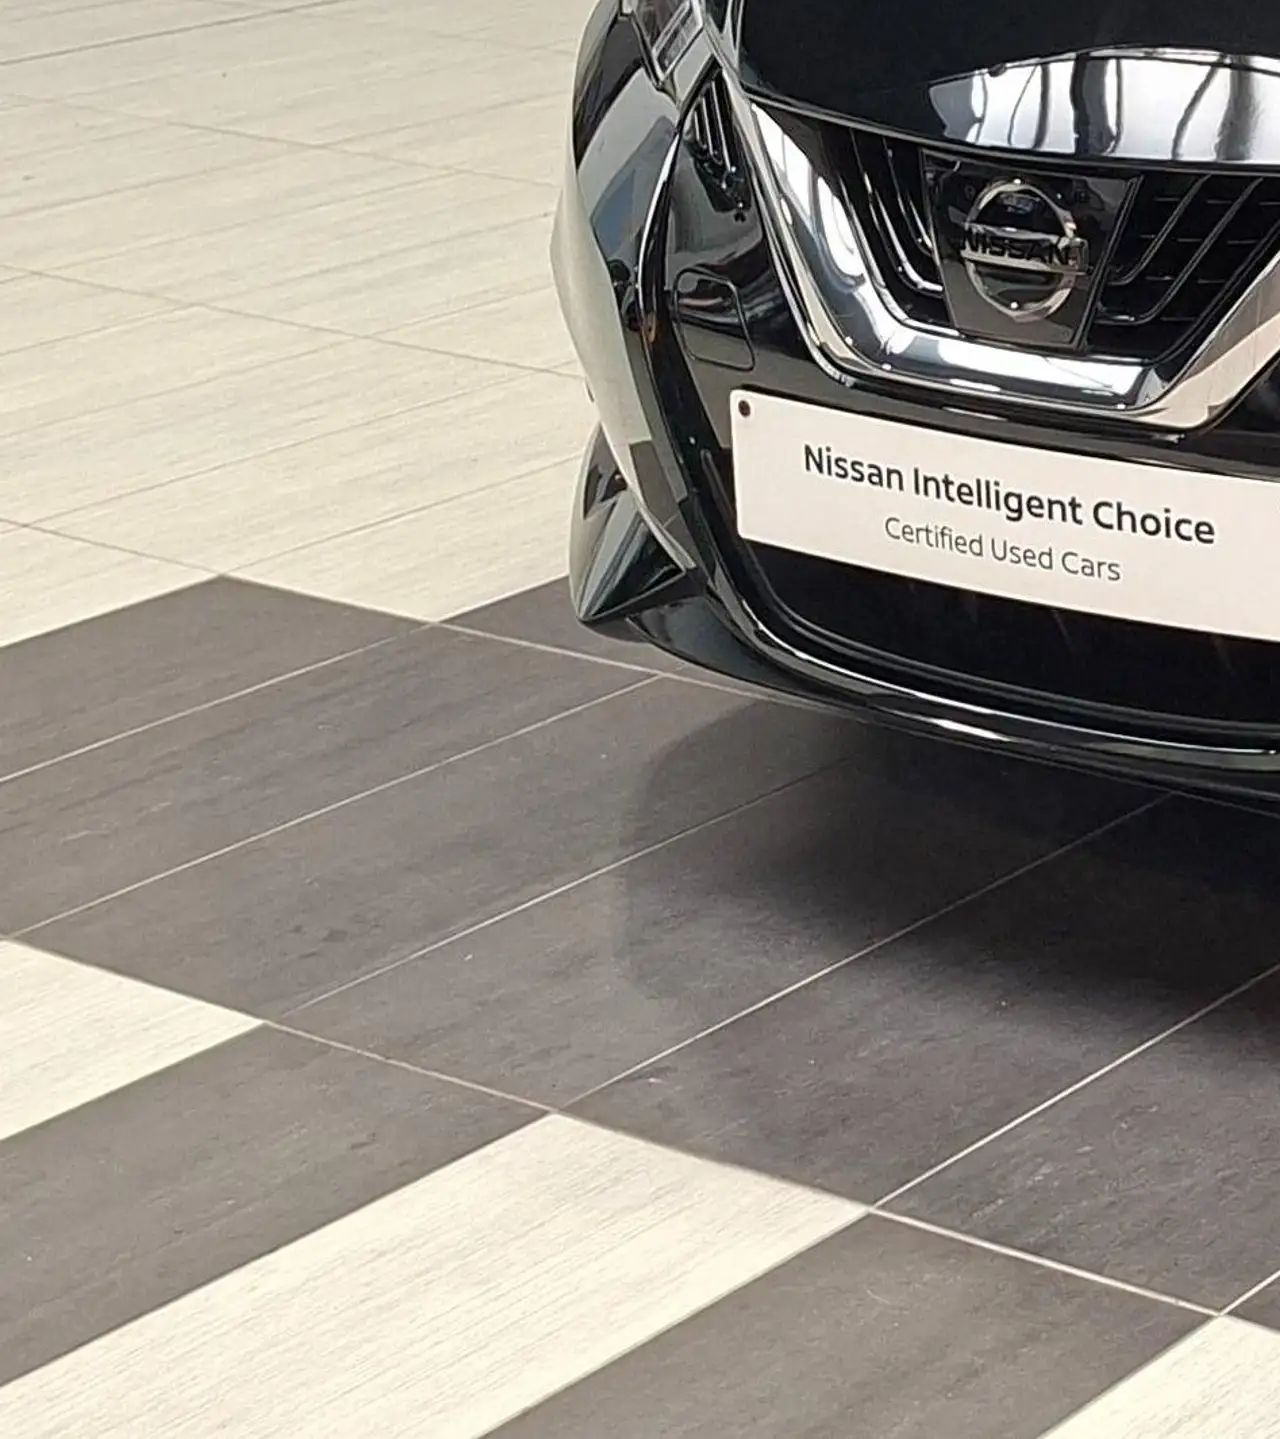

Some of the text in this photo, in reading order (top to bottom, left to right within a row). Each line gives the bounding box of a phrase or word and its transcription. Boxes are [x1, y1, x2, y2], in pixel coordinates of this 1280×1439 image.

[961, 225, 1071, 267] NISSAN
[804, 444, 1215, 544] Nissan Intelligent Choice
[885, 517, 1121, 581] Certified Used Cars
